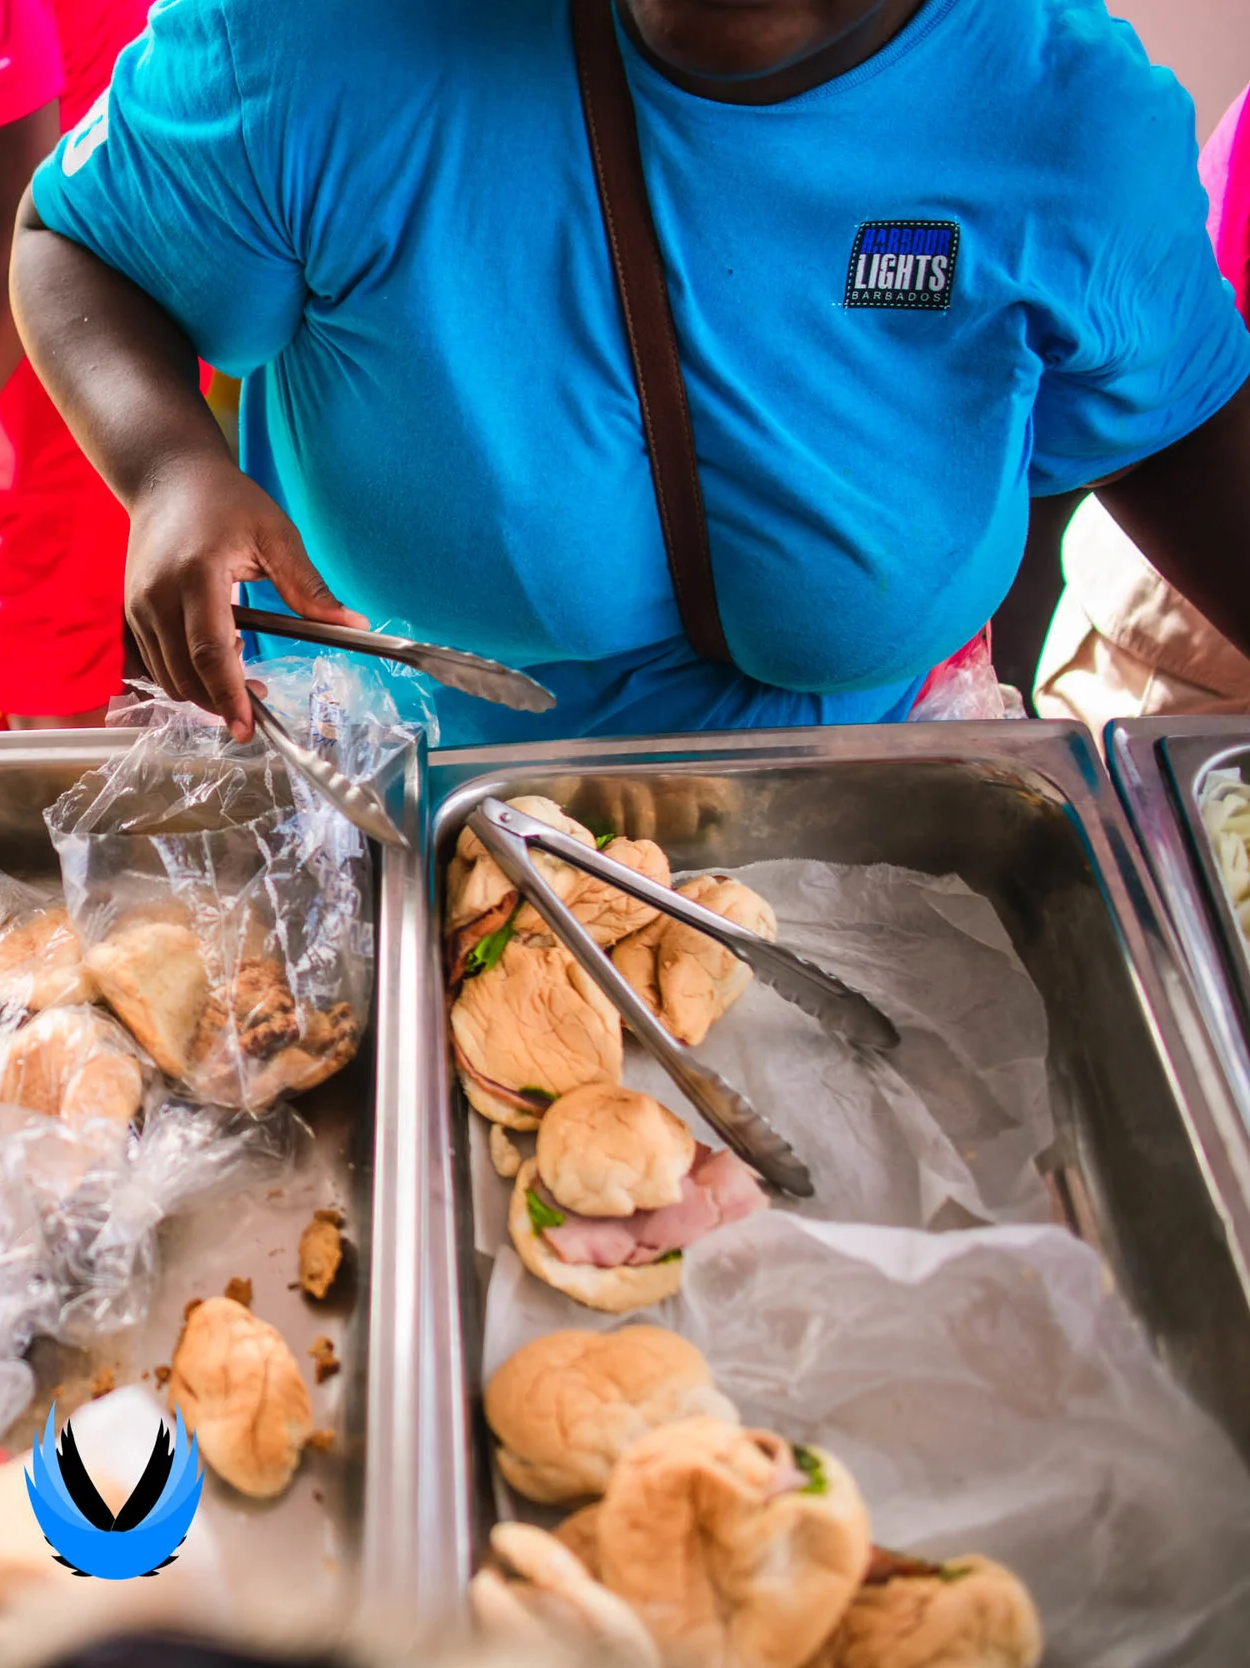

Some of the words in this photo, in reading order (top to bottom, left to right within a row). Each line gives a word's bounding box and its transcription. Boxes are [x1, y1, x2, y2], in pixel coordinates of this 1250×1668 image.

[860, 228, 952, 256] HARBOUR
[854, 253, 948, 291] LIGHTS
[851, 291, 941, 301] BARBADOS
